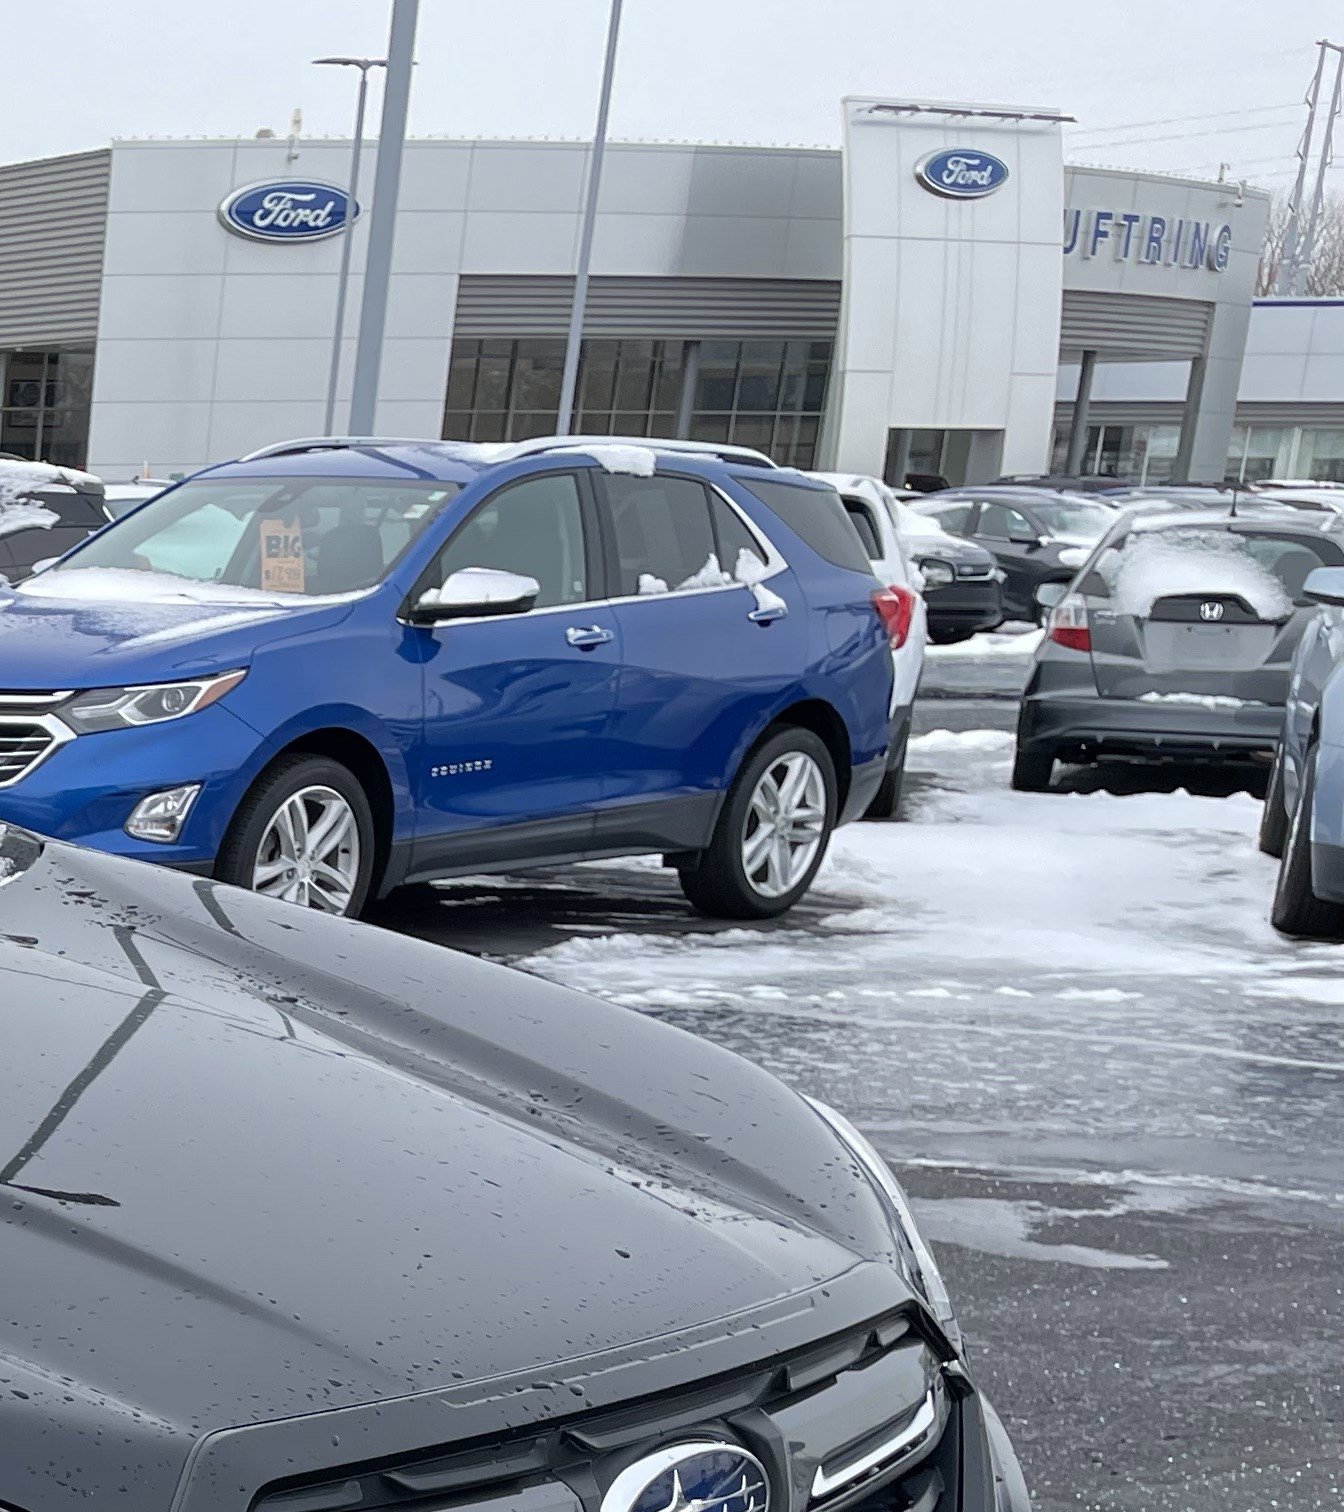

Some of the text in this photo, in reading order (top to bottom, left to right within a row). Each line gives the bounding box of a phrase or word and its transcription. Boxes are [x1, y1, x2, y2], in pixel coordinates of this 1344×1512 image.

[942, 156, 993, 185] Ford
[253, 191, 335, 228] Ford
[265, 535, 302, 558] BIG
